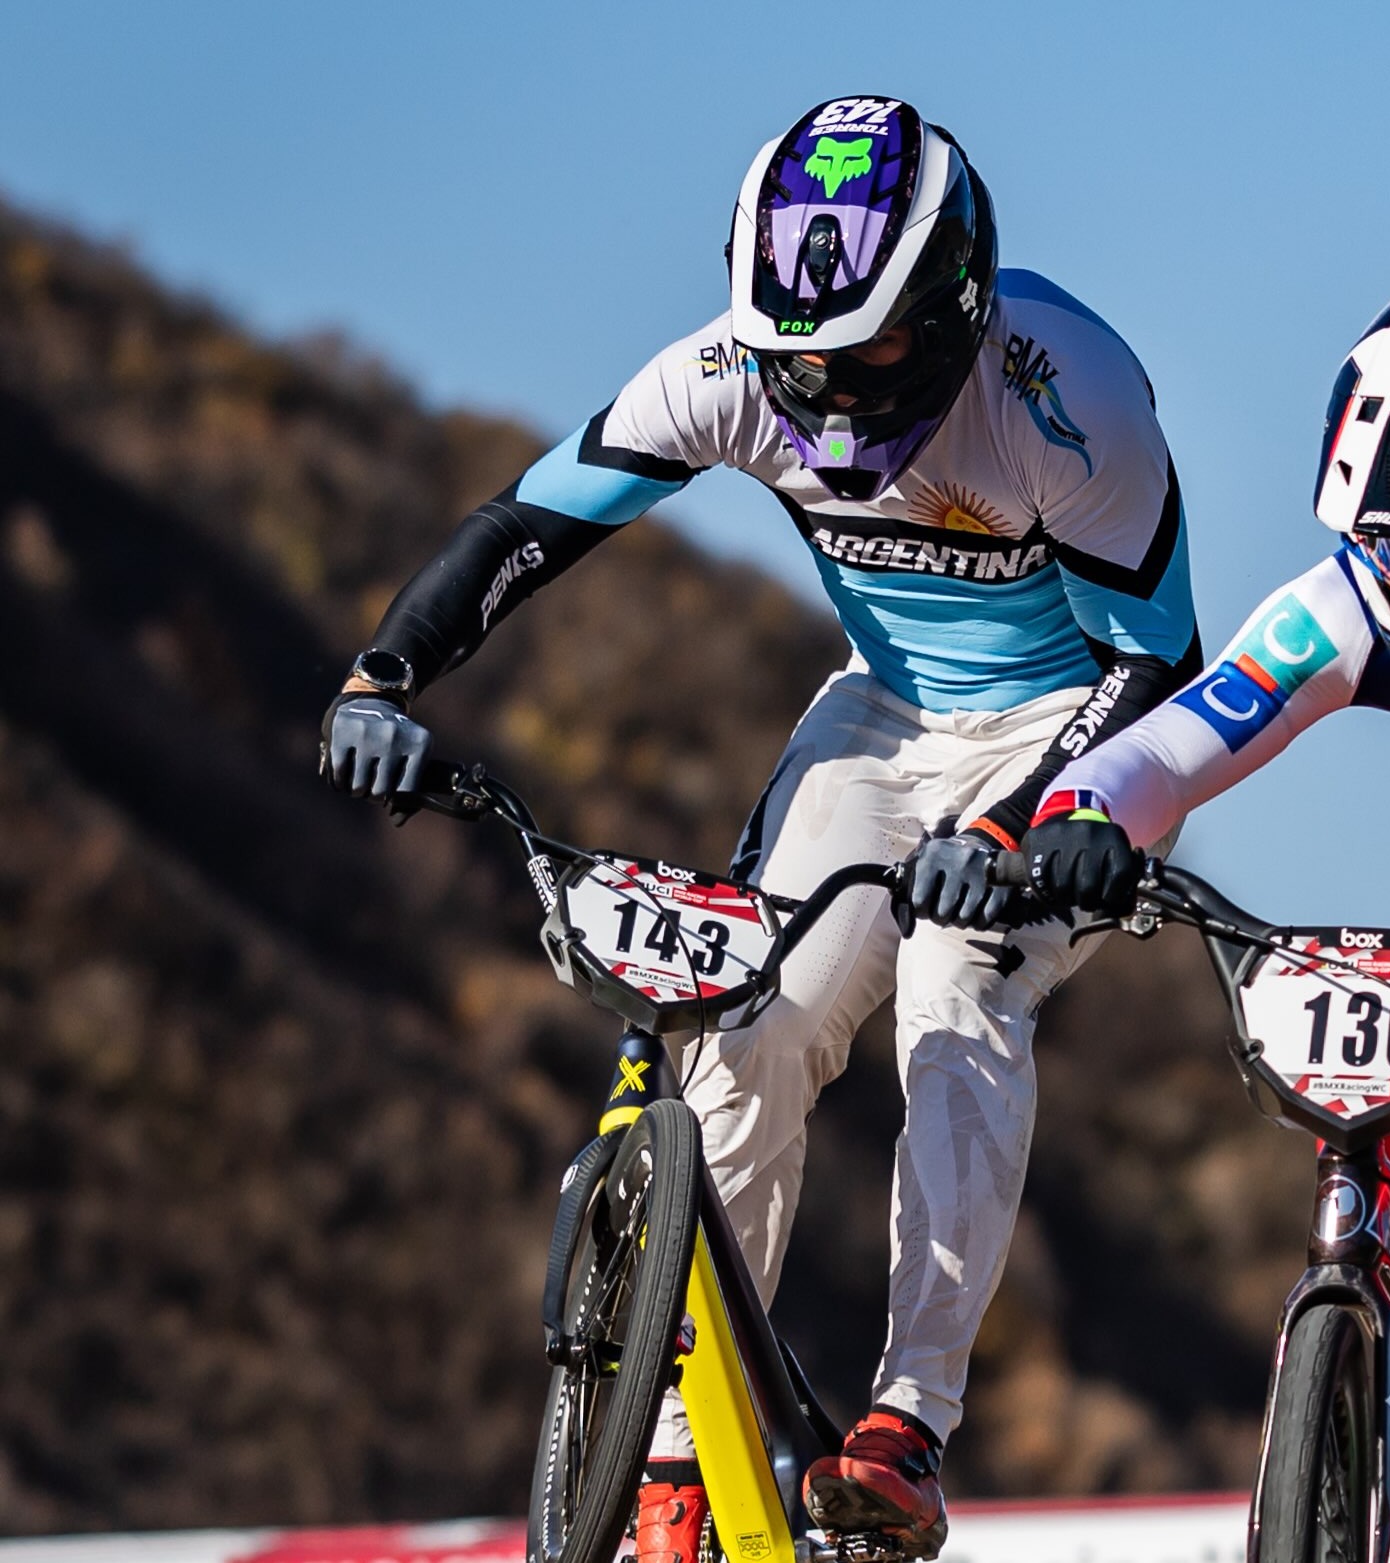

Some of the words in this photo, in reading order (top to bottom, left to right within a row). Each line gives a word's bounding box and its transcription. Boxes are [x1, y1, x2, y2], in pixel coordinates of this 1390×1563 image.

[812, 99, 902, 126] 143
[779, 321, 815, 333] FOX
[700, 342, 747, 380] BM
[1002, 333, 1060, 405] BMX
[811, 528, 1048, 580] ARGENTINA
[480, 541, 545, 631] PENKS
[657, 861, 697, 884] box
[614, 900, 730, 976] 143
[1340, 928, 1383, 949] box
